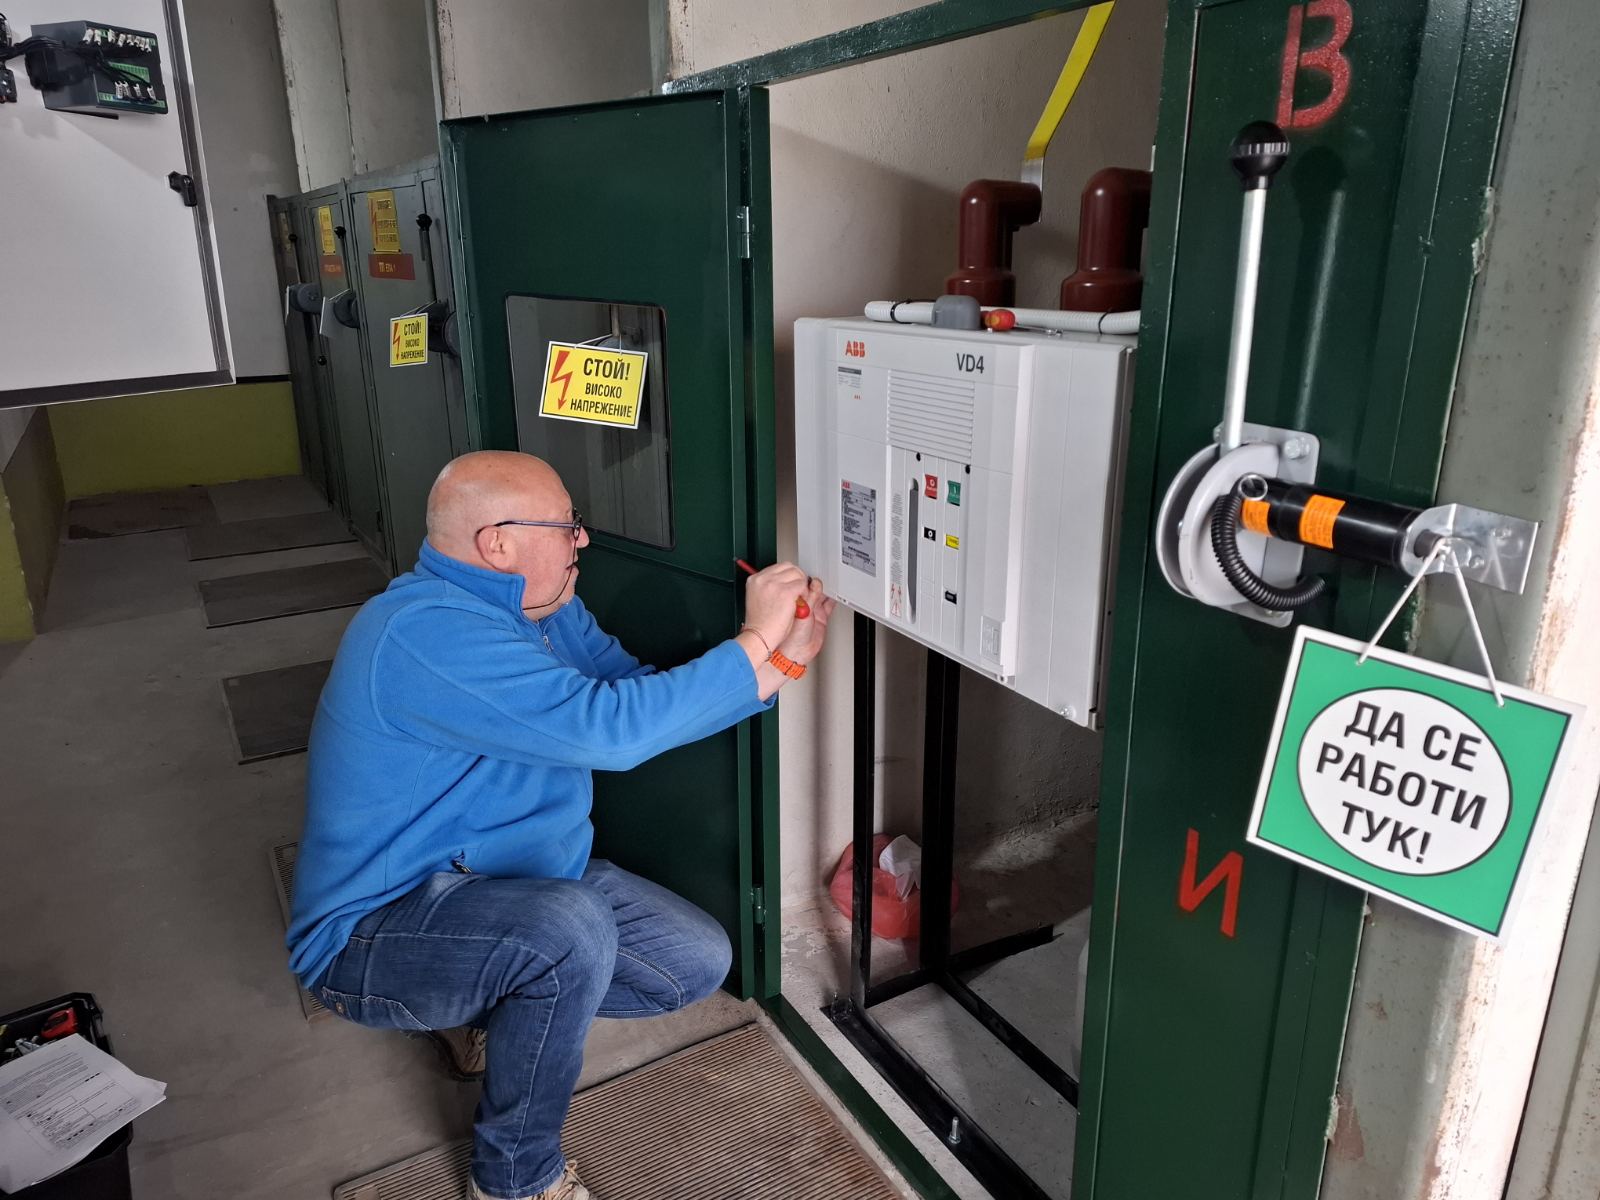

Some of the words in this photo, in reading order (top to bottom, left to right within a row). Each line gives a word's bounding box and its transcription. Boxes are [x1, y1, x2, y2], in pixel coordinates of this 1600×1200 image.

[403, 320, 422, 336] СТОЙ!
[845, 341, 866, 358] ABB
[583, 357, 631, 381] СТОЙ!
[956, 352, 985, 374] VD4
[585, 382, 623, 399] ВИСОКО
[570, 398, 633, 418] НАПРЕЖЕНИЕ
[1343, 700, 1405, 749] ДА
[1422, 724, 1482, 772] СЕ
[1316, 741, 1487, 830] РАБОТИ
[1340, 801, 1432, 864] ТУК!
[1177, 827, 1244, 938] И
